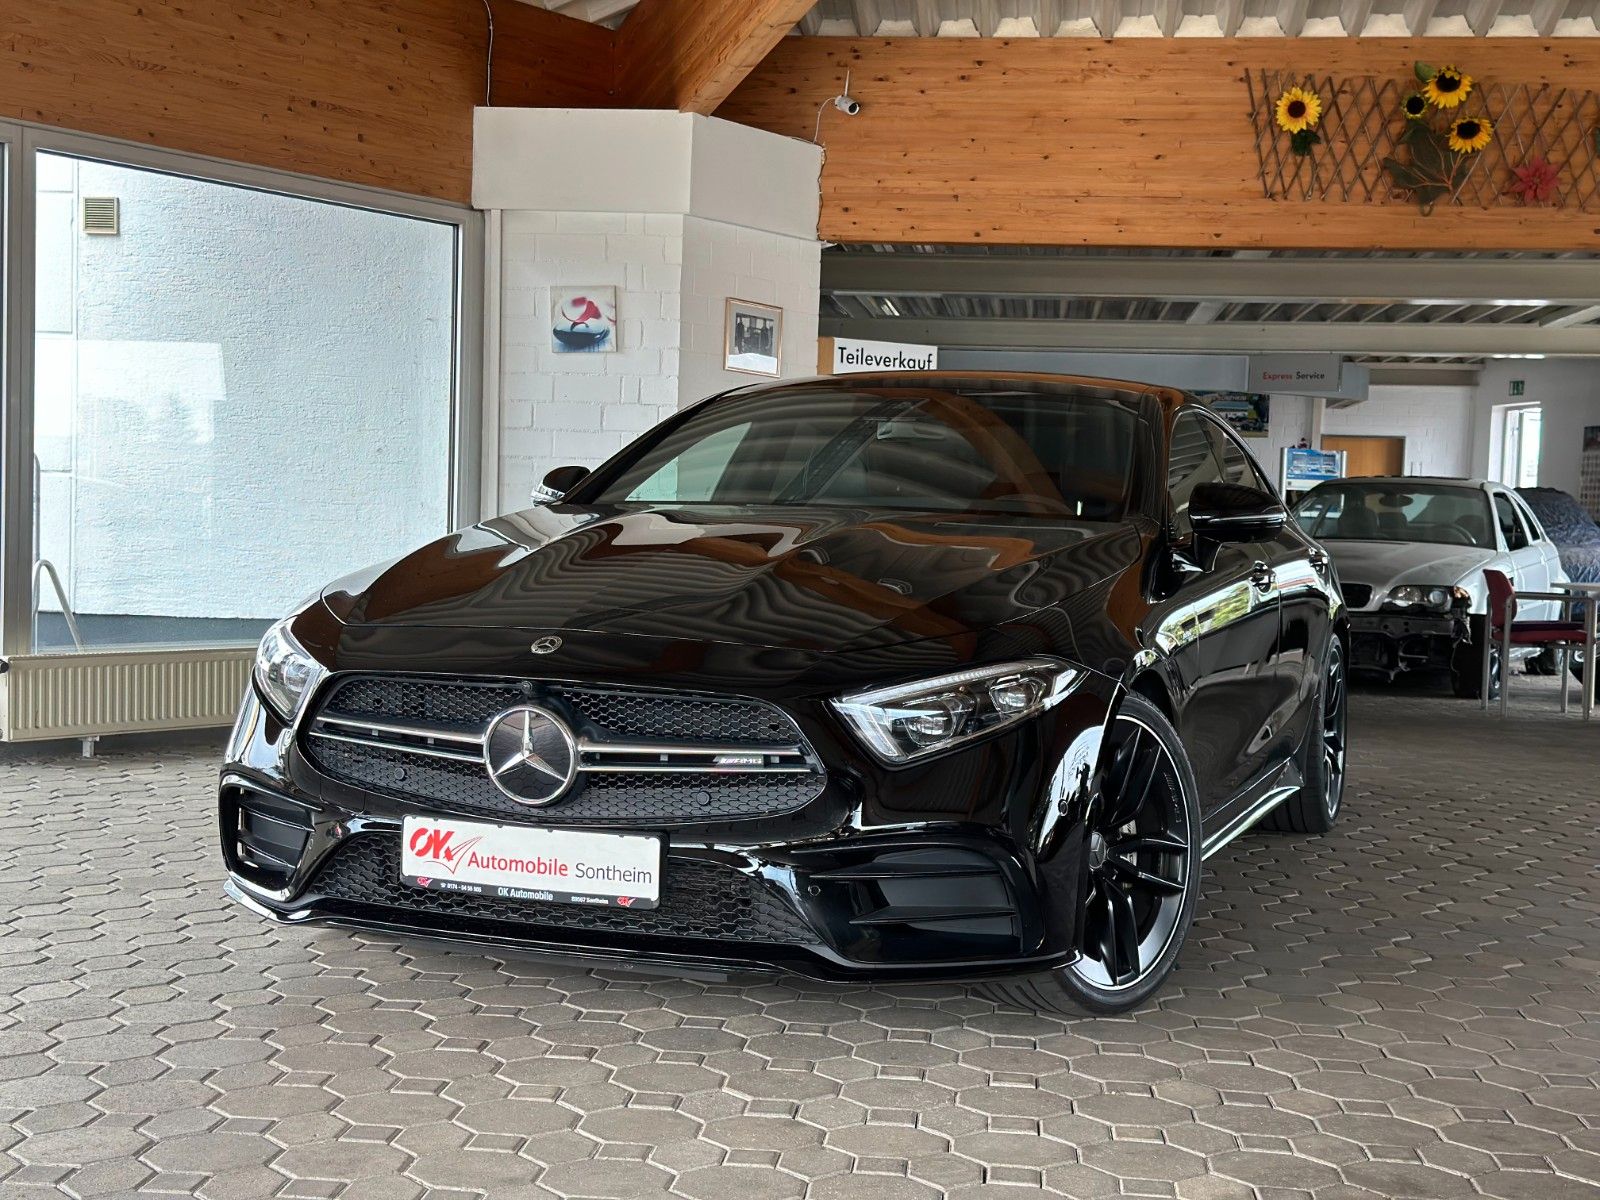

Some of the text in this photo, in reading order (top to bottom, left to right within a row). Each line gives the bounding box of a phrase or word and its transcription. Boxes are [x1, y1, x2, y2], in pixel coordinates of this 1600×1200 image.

[838, 346, 932, 370] Teileverkauf
[1263, 371, 1325, 382] Express Service
[409, 827, 455, 862] OK
[468, 851, 652, 884] Automobile Sontheim
[498, 887, 554, 901] OK Automobile
